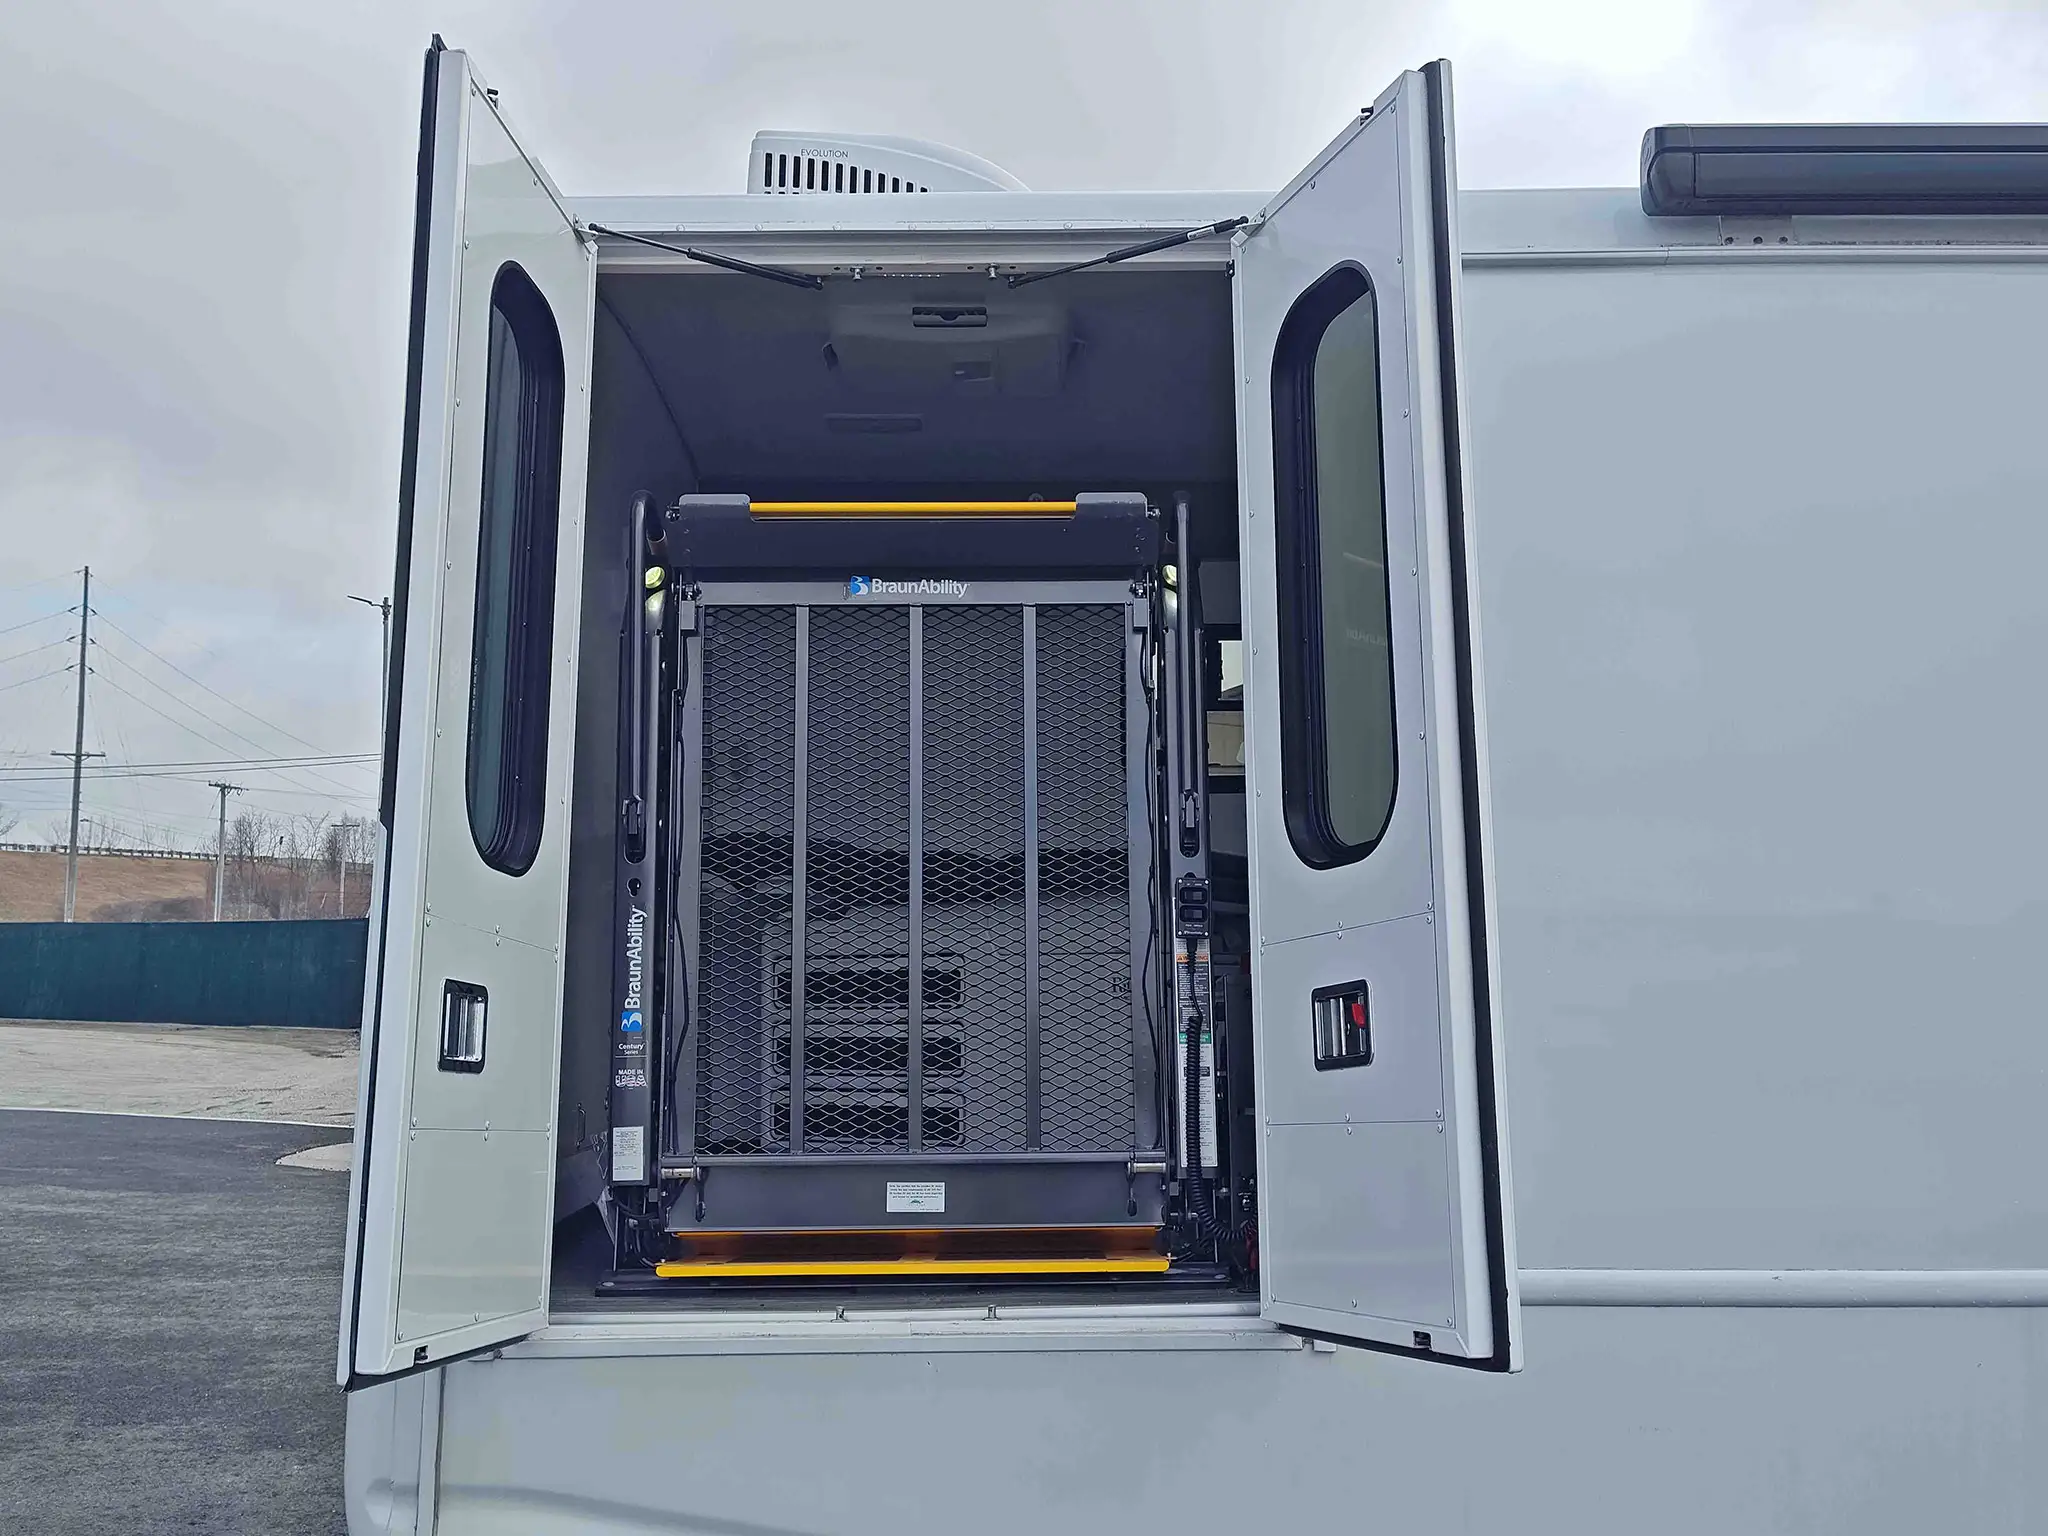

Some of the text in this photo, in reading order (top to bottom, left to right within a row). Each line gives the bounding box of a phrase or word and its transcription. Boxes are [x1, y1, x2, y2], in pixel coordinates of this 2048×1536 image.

[801, 149, 849, 158] EVOLUTION
[871, 578, 968, 598] BraunAbility
[624, 907, 648, 1009] BraunAbility
[614, 1074, 647, 1088] USA
